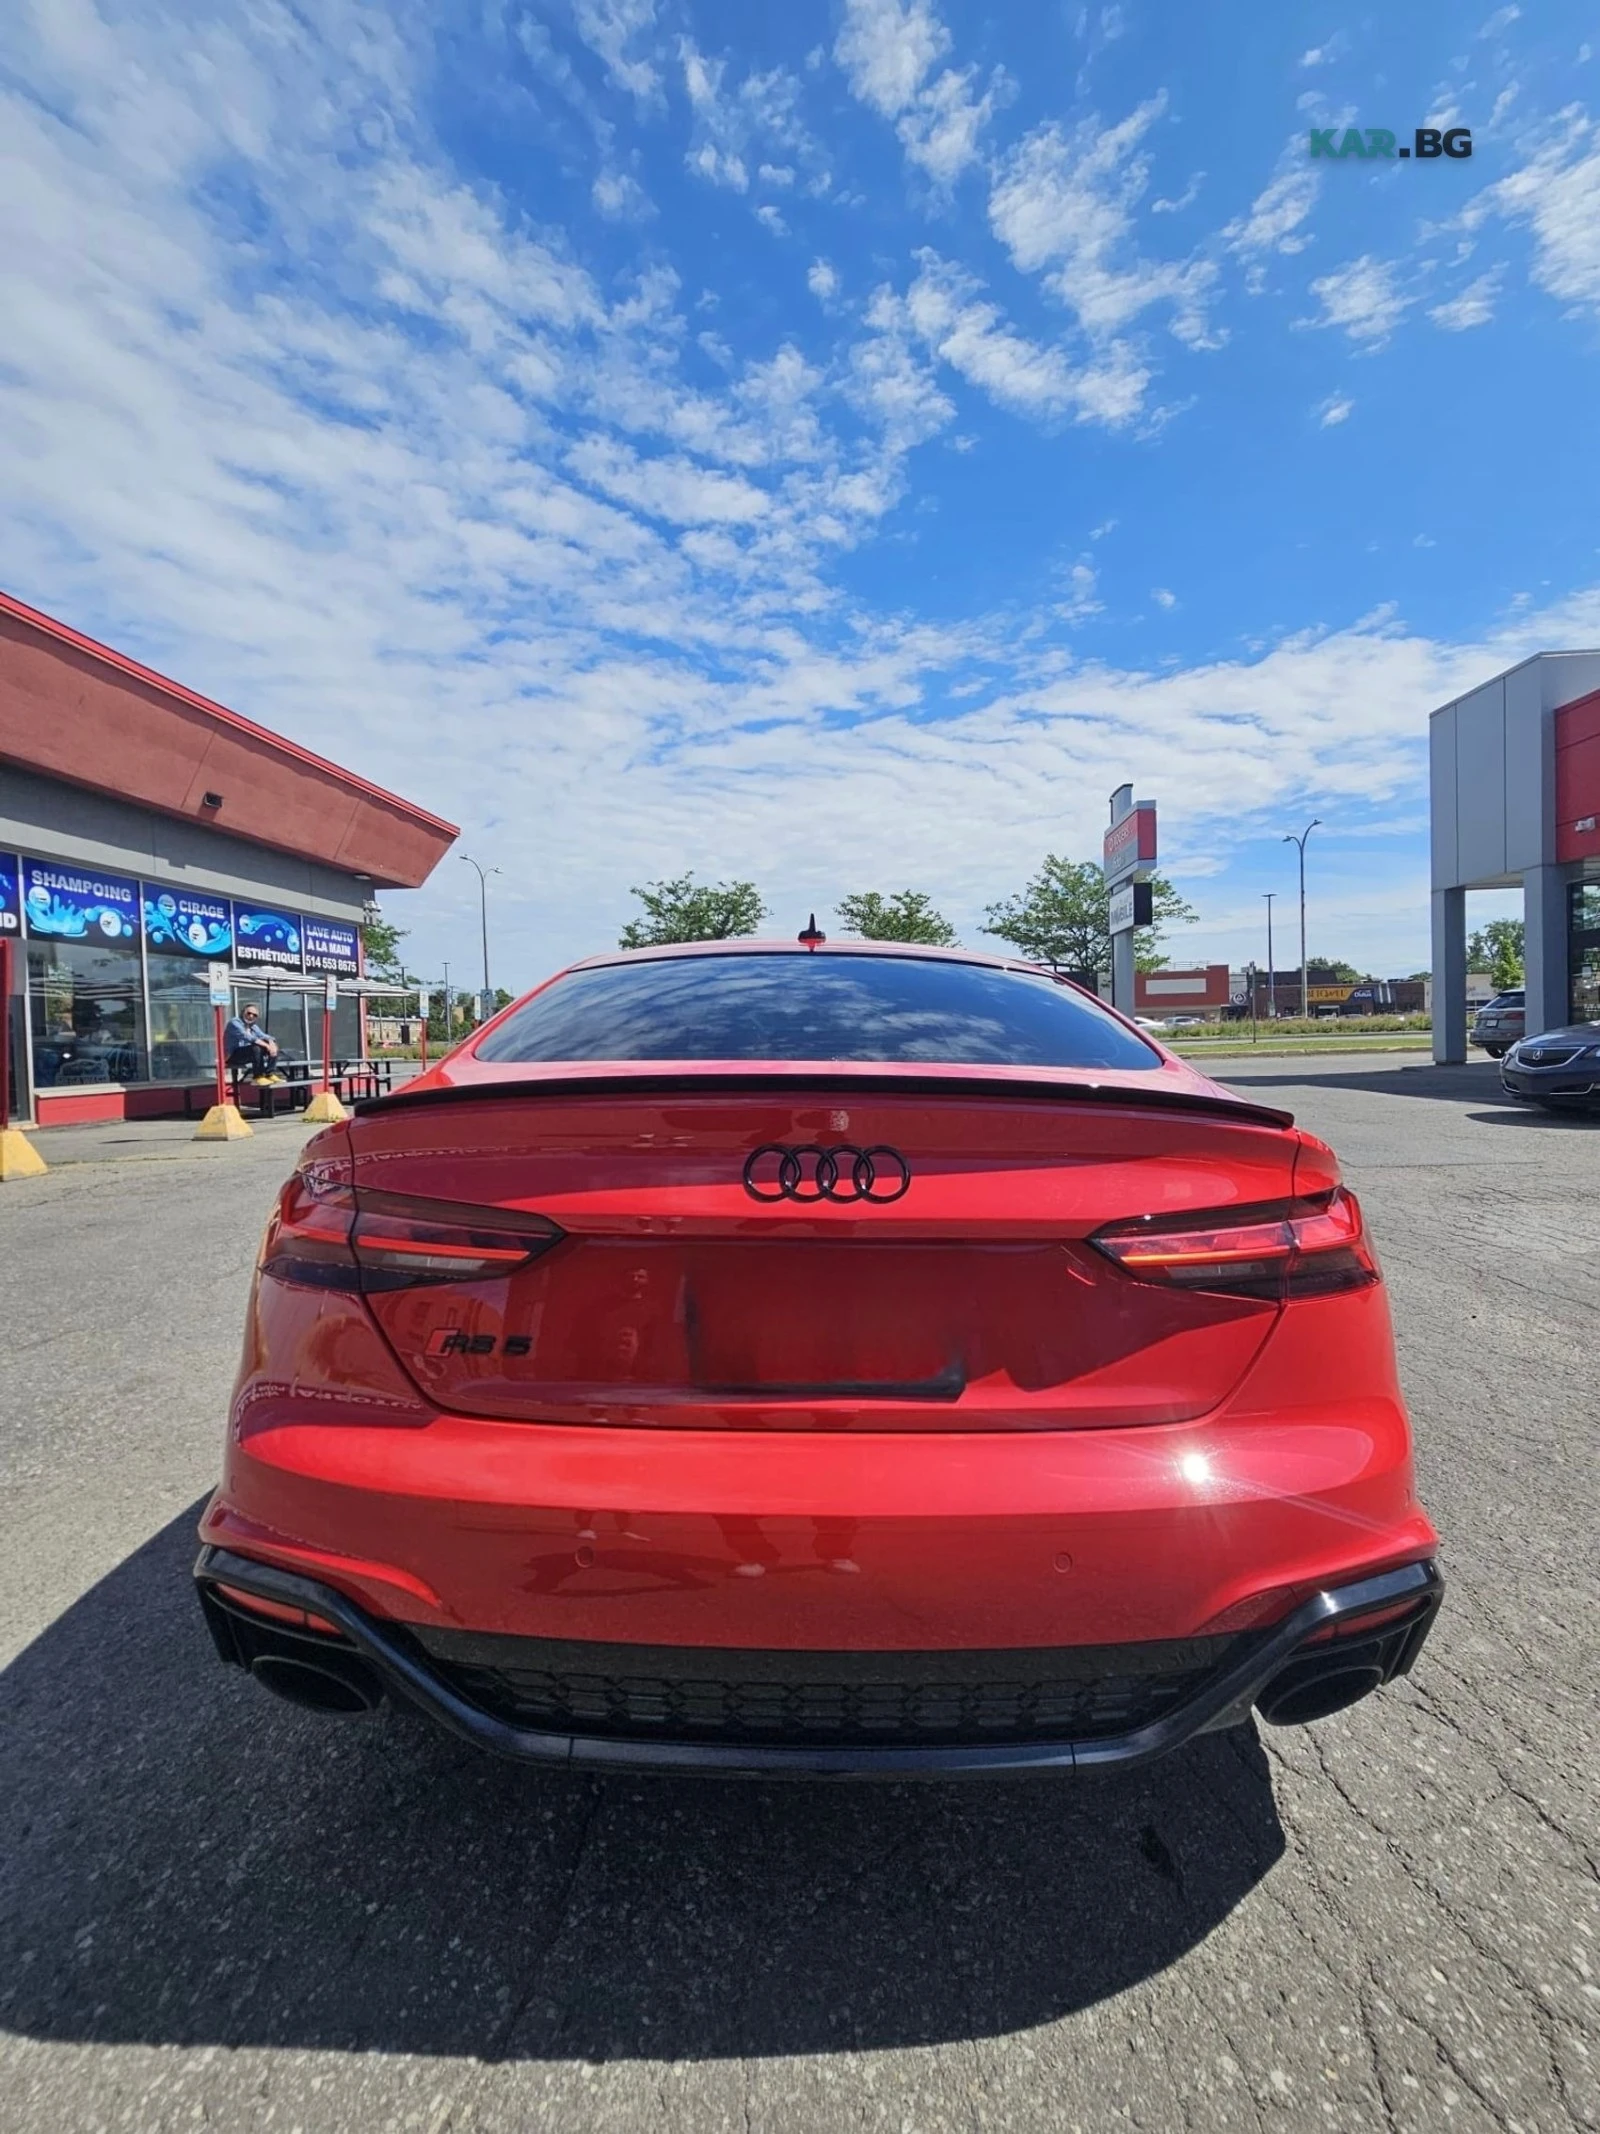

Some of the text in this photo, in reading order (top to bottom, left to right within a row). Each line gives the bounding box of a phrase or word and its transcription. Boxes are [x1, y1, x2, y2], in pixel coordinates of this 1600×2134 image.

[31, 870, 131, 902] SHAMPOING
[179, 900, 224, 919] CIRAGE
[307, 924, 353, 943] LAVE AUTO
[237, 946, 300, 964] ESTHÉTIQUE
[316, 942, 327, 952] LA
[329, 945, 350, 956] MAIN
[306, 955, 321, 968] 514
[323, 957, 337, 970] 553
